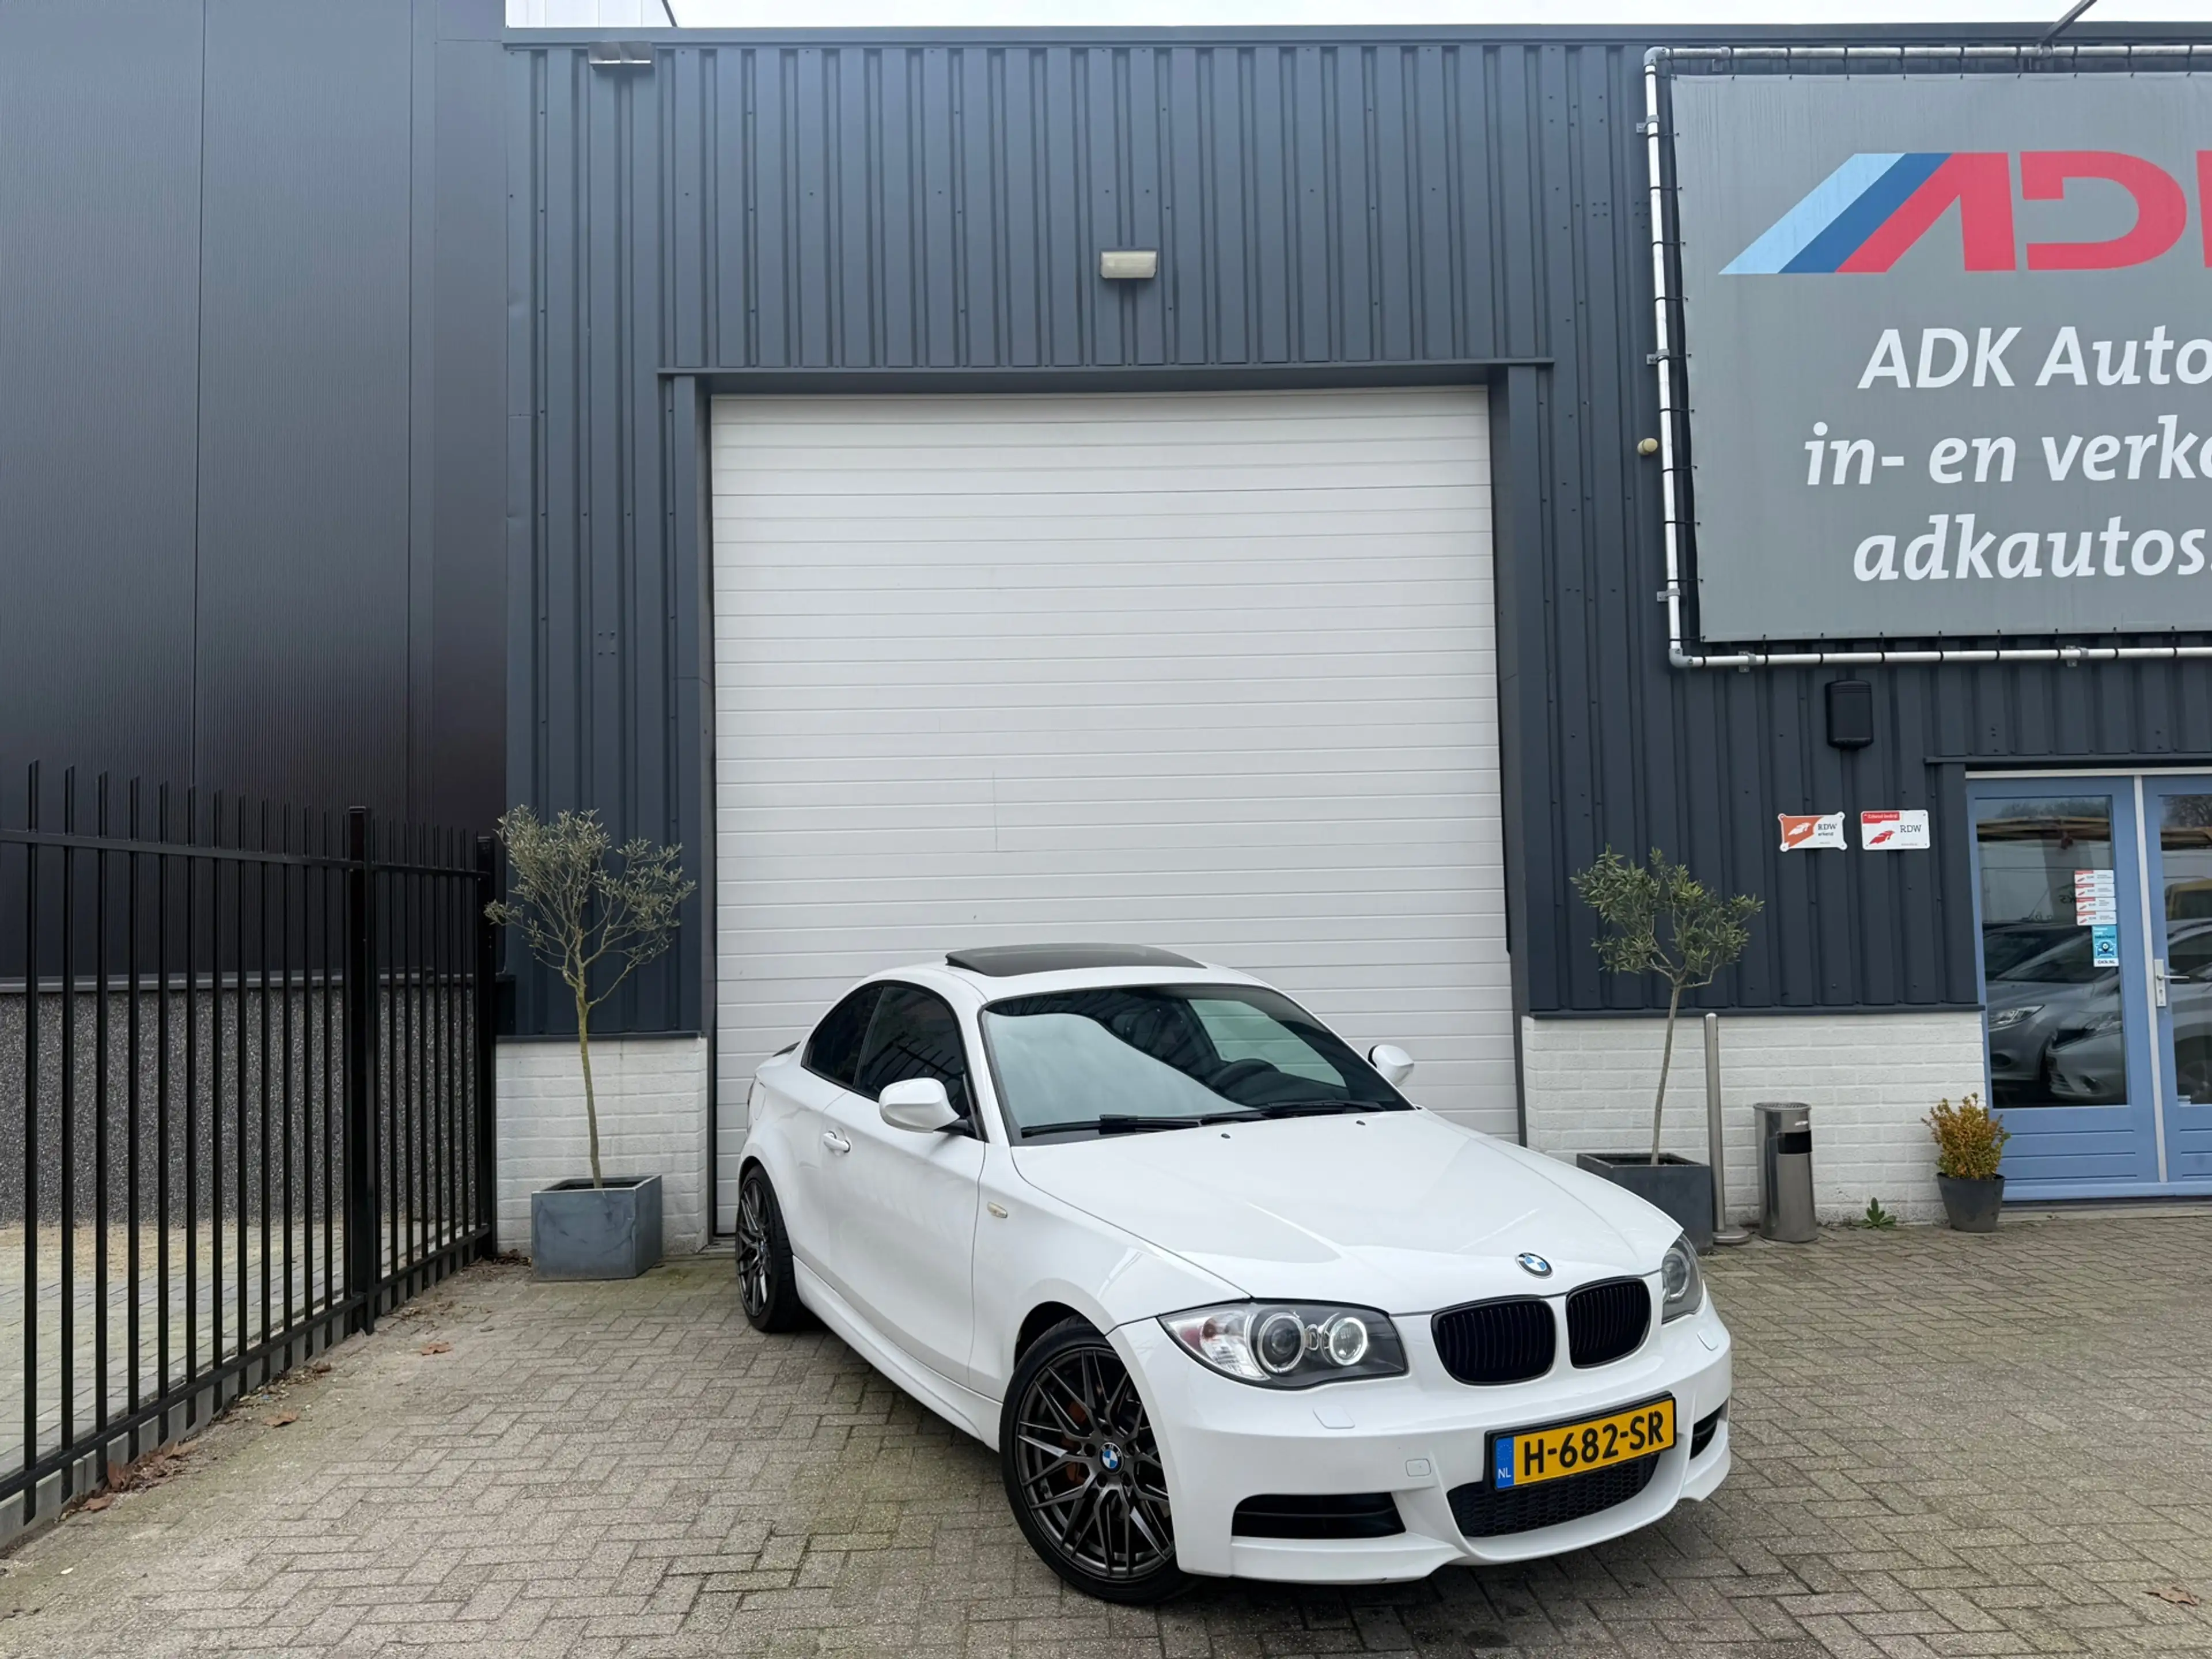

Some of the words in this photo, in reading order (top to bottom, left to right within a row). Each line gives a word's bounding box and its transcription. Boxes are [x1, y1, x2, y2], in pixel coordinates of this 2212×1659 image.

[1836, 151, 2212, 274] AD
[1858, 327, 2021, 388] ADK
[2035, 325, 2212, 385] Auto
[1805, 422, 1904, 485] in-
[1929, 437, 2016, 483] en
[1853, 514, 2212, 581] adkautos
[1900, 824, 1922, 833] RDW
[1498, 1468, 1512, 1479] NL
[1524, 1410, 1664, 1476] H-682-SR
